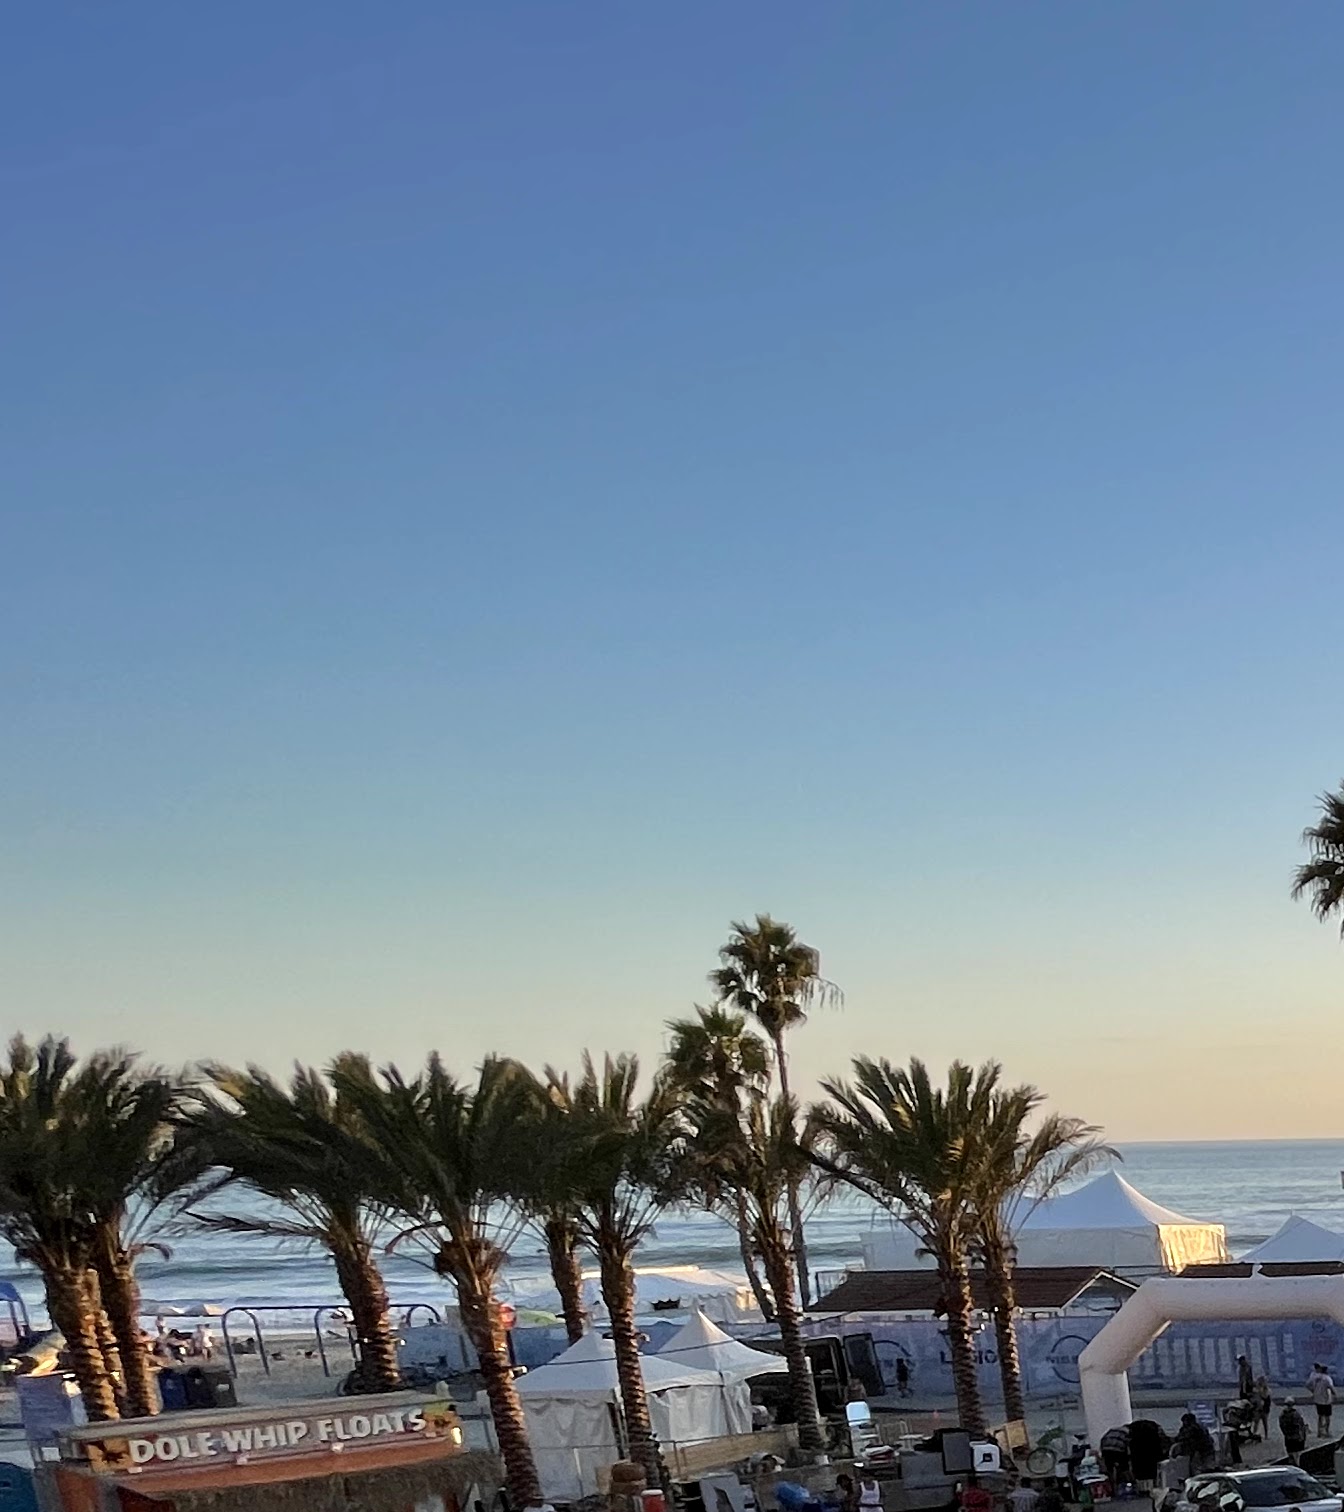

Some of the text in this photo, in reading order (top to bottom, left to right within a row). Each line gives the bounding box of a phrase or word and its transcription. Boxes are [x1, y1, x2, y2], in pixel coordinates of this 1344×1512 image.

[128, 1408, 426, 1464] DOLE WHIP FLOATS
